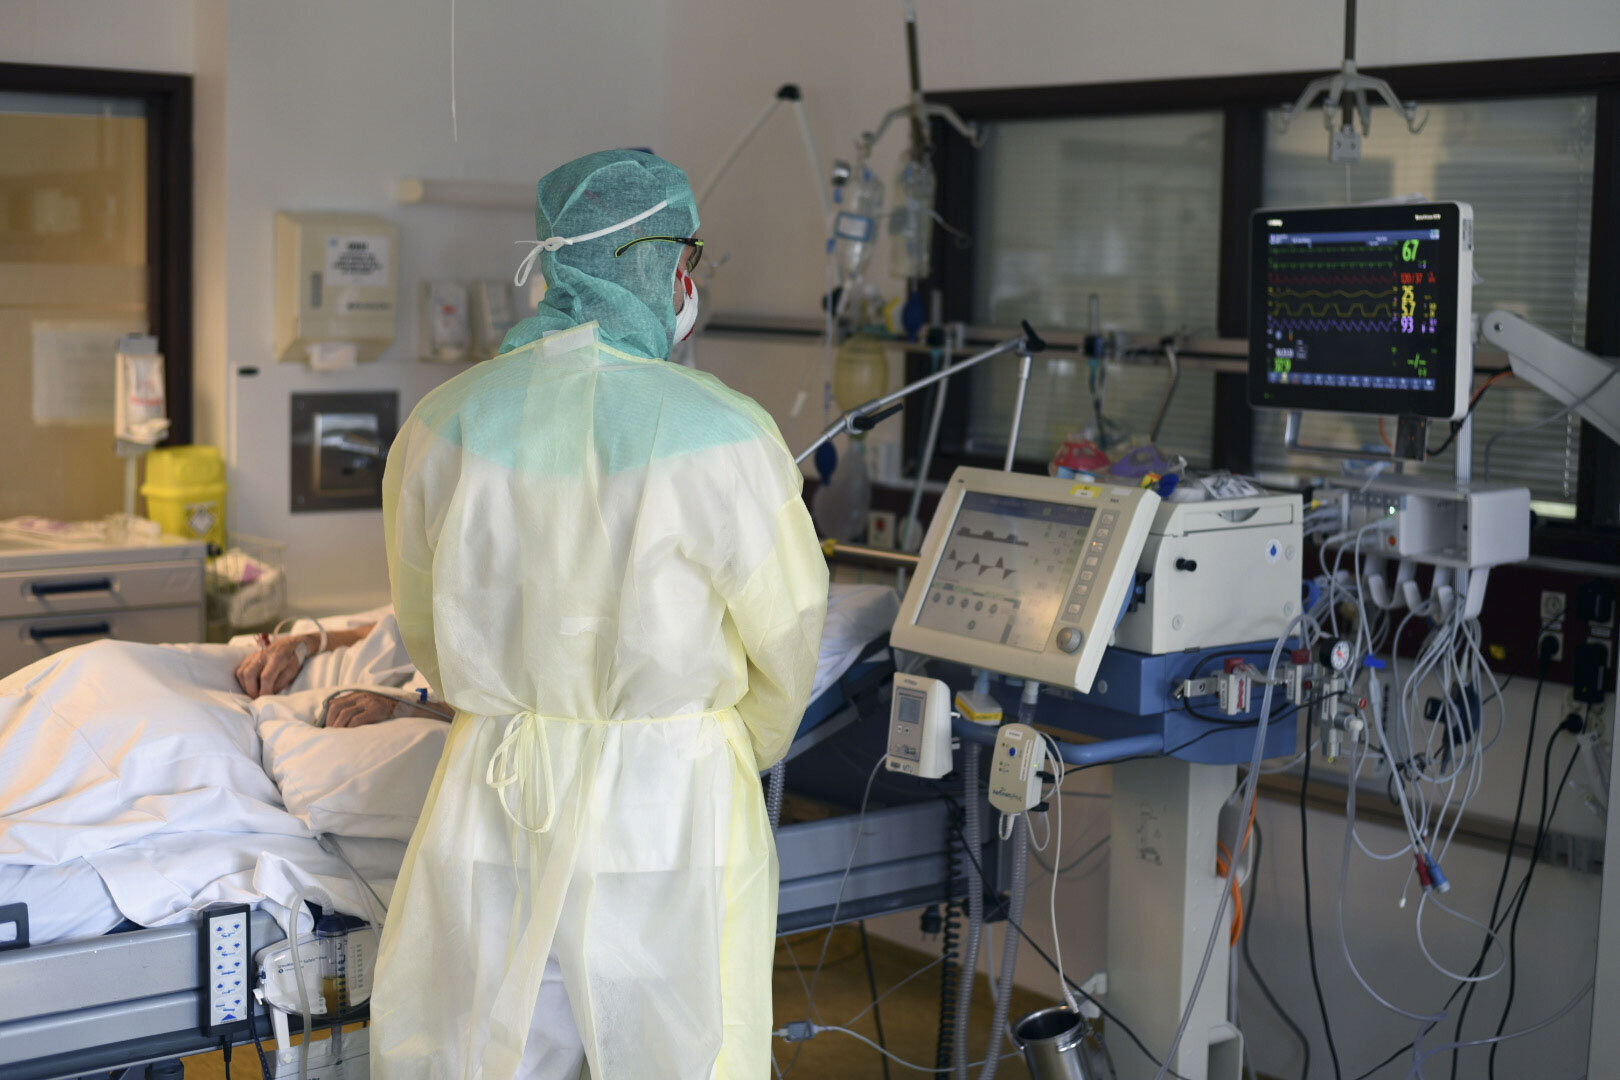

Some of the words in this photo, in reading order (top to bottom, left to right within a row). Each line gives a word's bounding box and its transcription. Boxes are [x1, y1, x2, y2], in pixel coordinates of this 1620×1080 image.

[1402, 239, 1420, 262] 67
[1401, 297, 1417, 317] 57
[1400, 315, 1415, 334] 93
